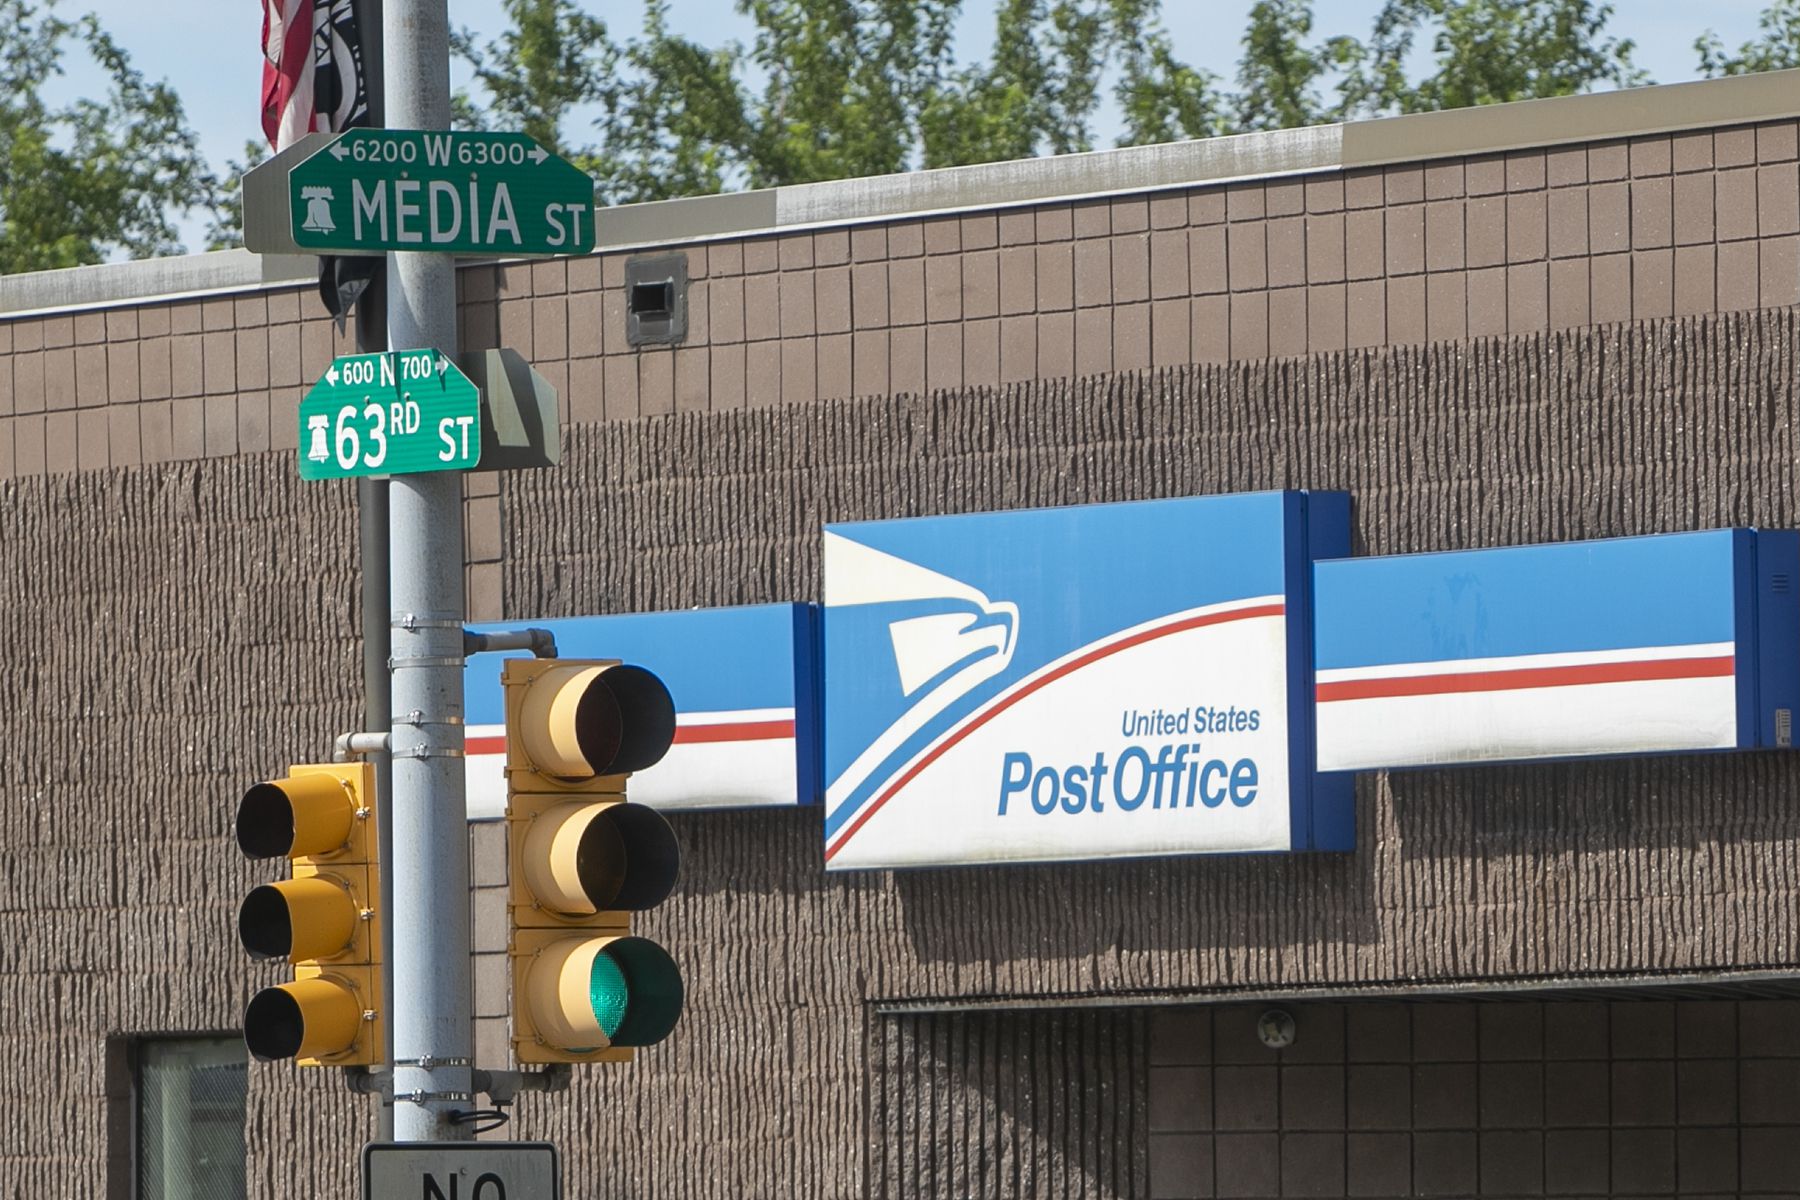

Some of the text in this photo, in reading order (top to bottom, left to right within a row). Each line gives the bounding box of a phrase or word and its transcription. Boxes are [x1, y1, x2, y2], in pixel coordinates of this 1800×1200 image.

[352, 134, 525, 168] 6200 W 6300
[351, 178, 587, 247] MEDIA ST
[342, 354, 432, 388] 600 N 700
[438, 416, 474, 462] ST
[1121, 705, 1261, 738] United States
